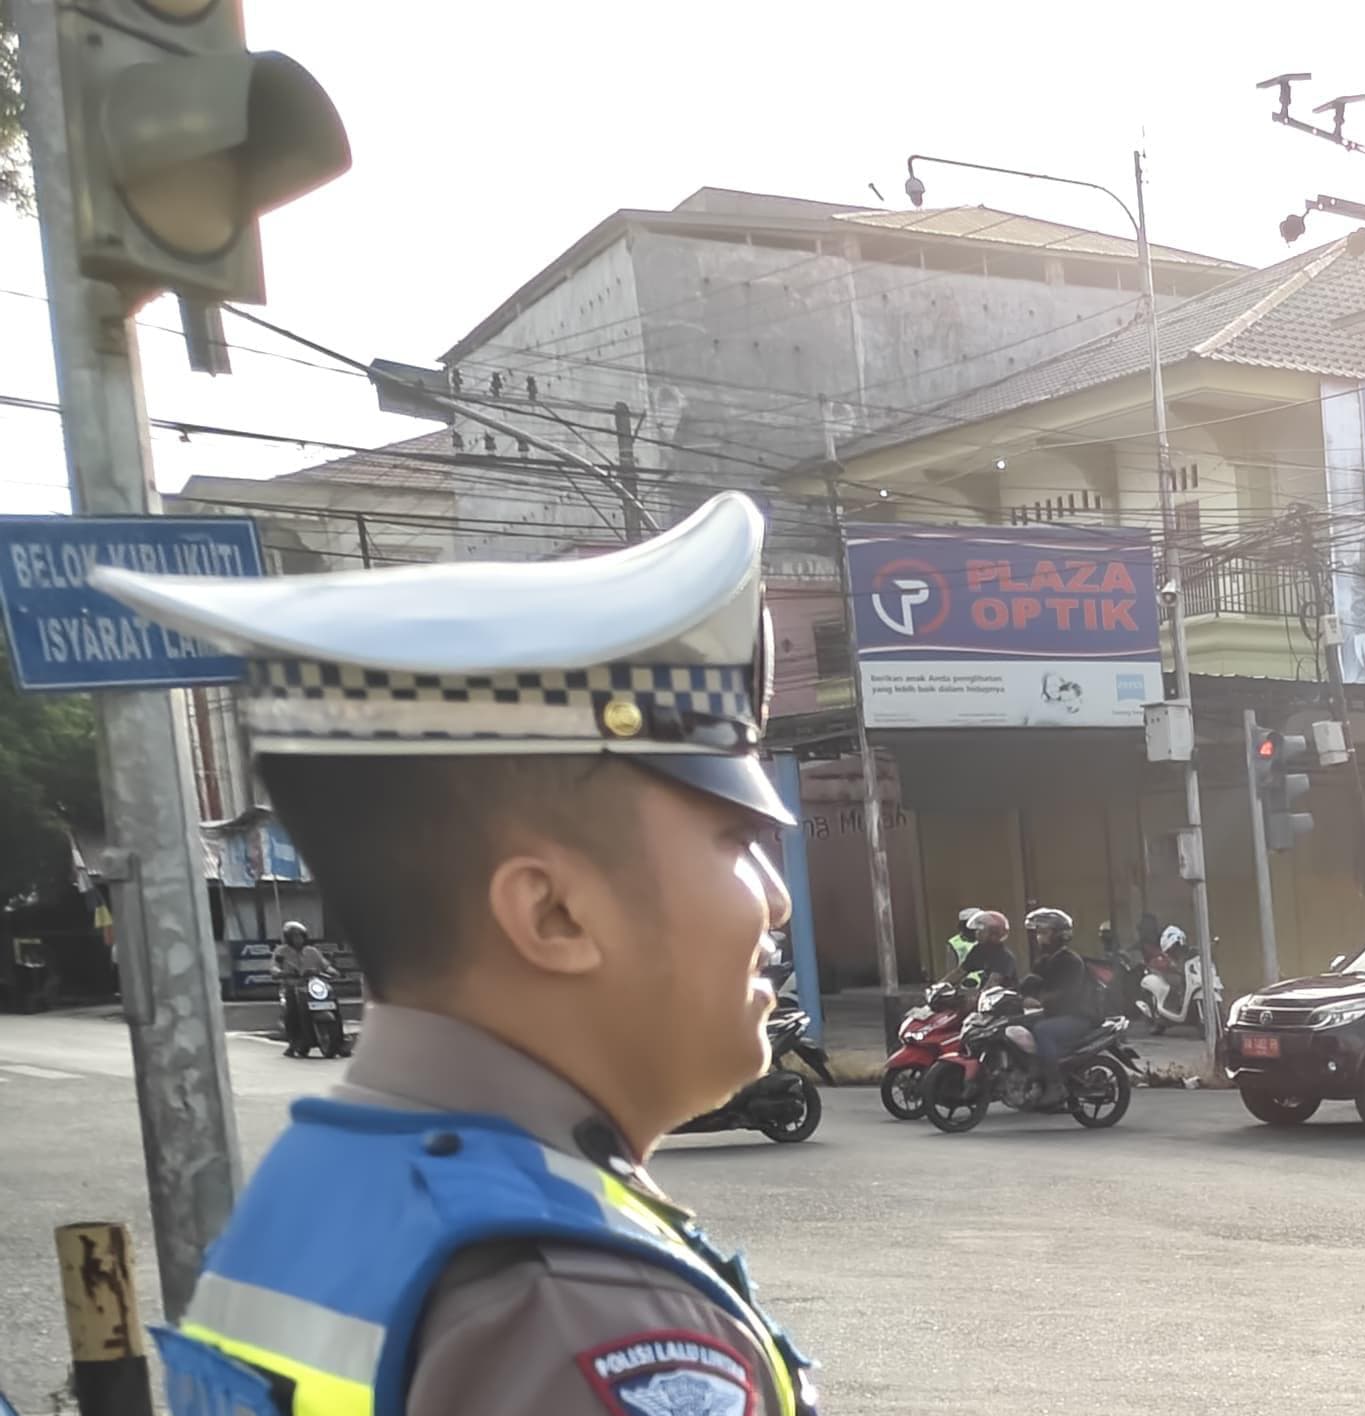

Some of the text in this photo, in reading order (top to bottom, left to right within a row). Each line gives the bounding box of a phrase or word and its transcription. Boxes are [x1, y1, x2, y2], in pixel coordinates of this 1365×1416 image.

[965, 559, 1136, 593] PLAZA
[970, 598, 1139, 631] OPTIK
[37, 616, 152, 662] ISYARAT
[595, 1342, 654, 1378] POLISI
[654, 1340, 699, 1362] LALU
